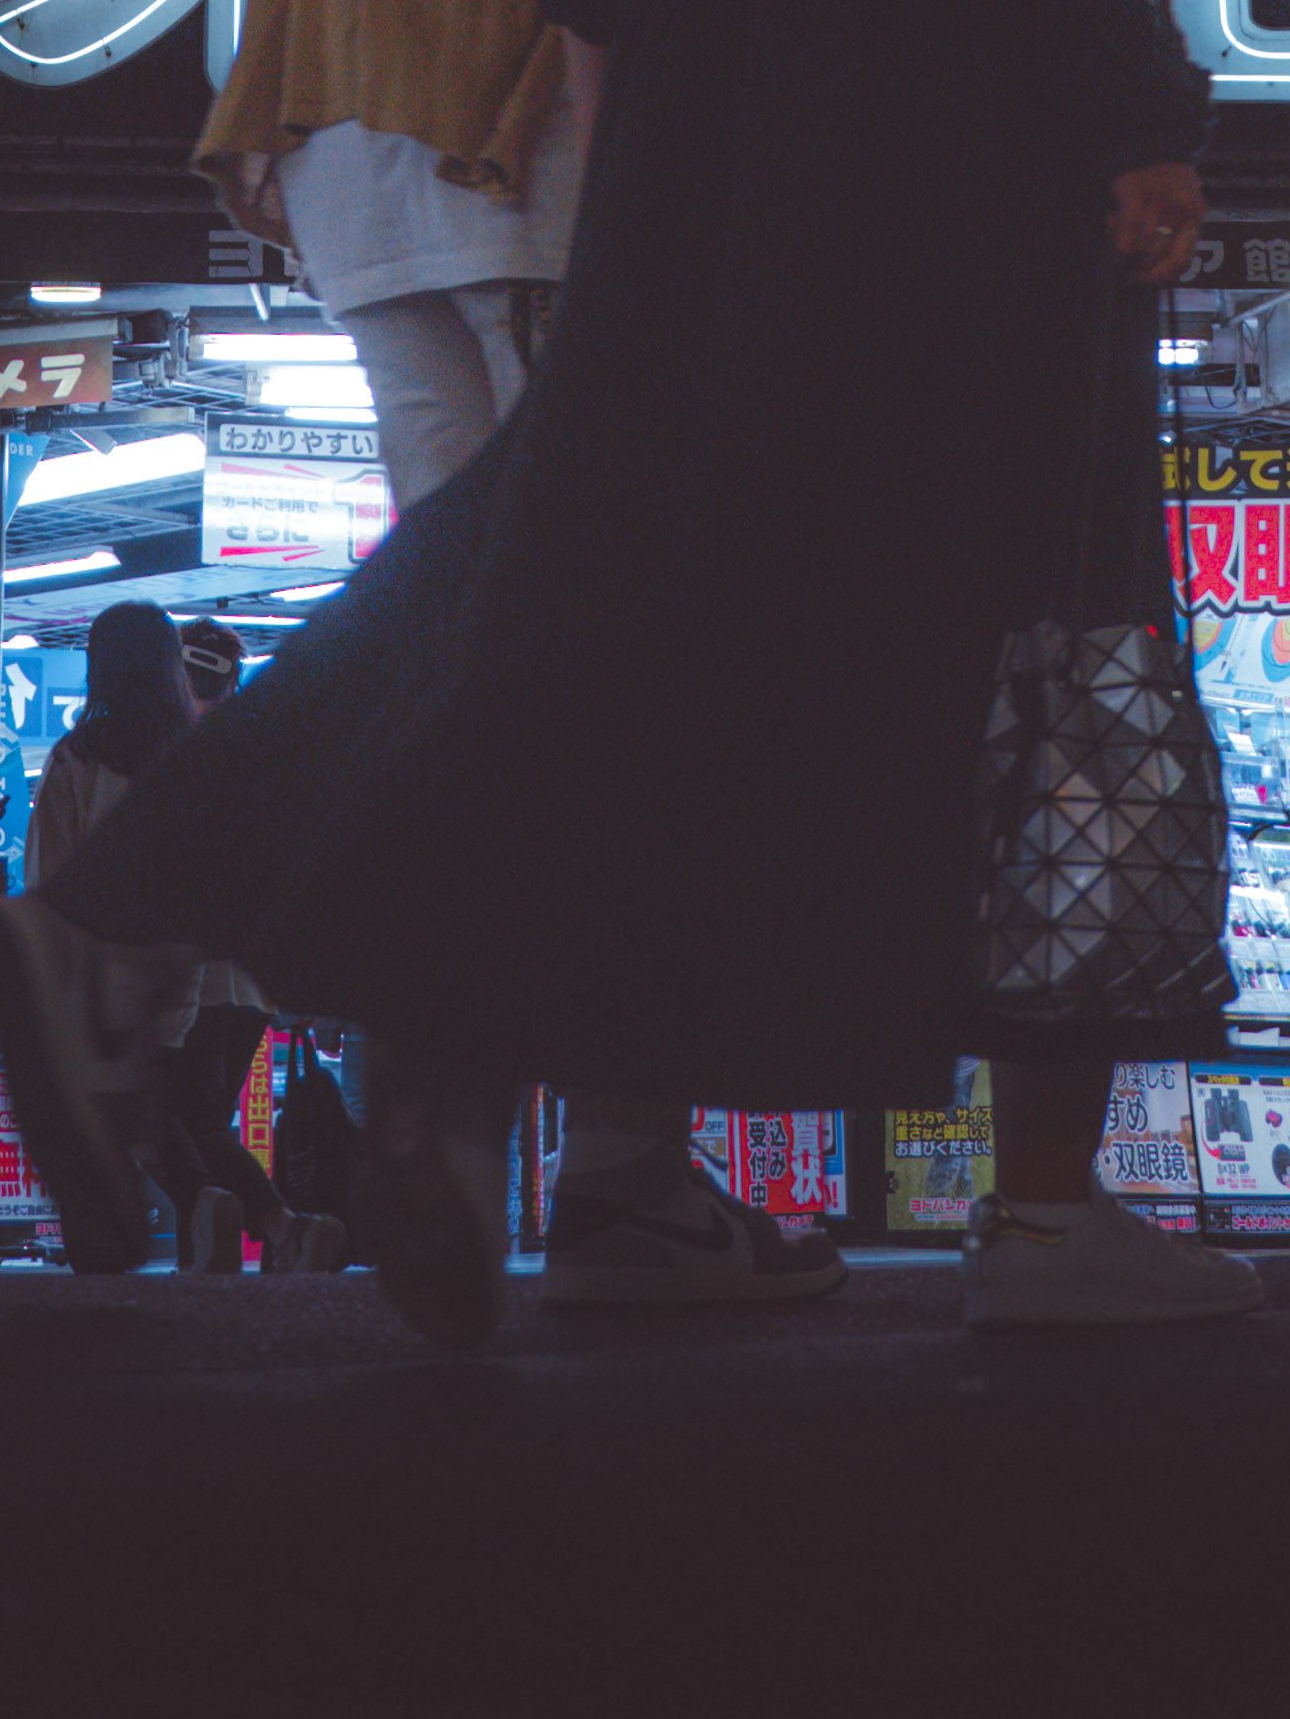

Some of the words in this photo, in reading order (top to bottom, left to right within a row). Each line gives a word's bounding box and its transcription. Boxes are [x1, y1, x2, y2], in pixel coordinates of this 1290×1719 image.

[224, 426, 377, 459] わかりやすい
[894, 1138, 995, 1159] お選びください。
